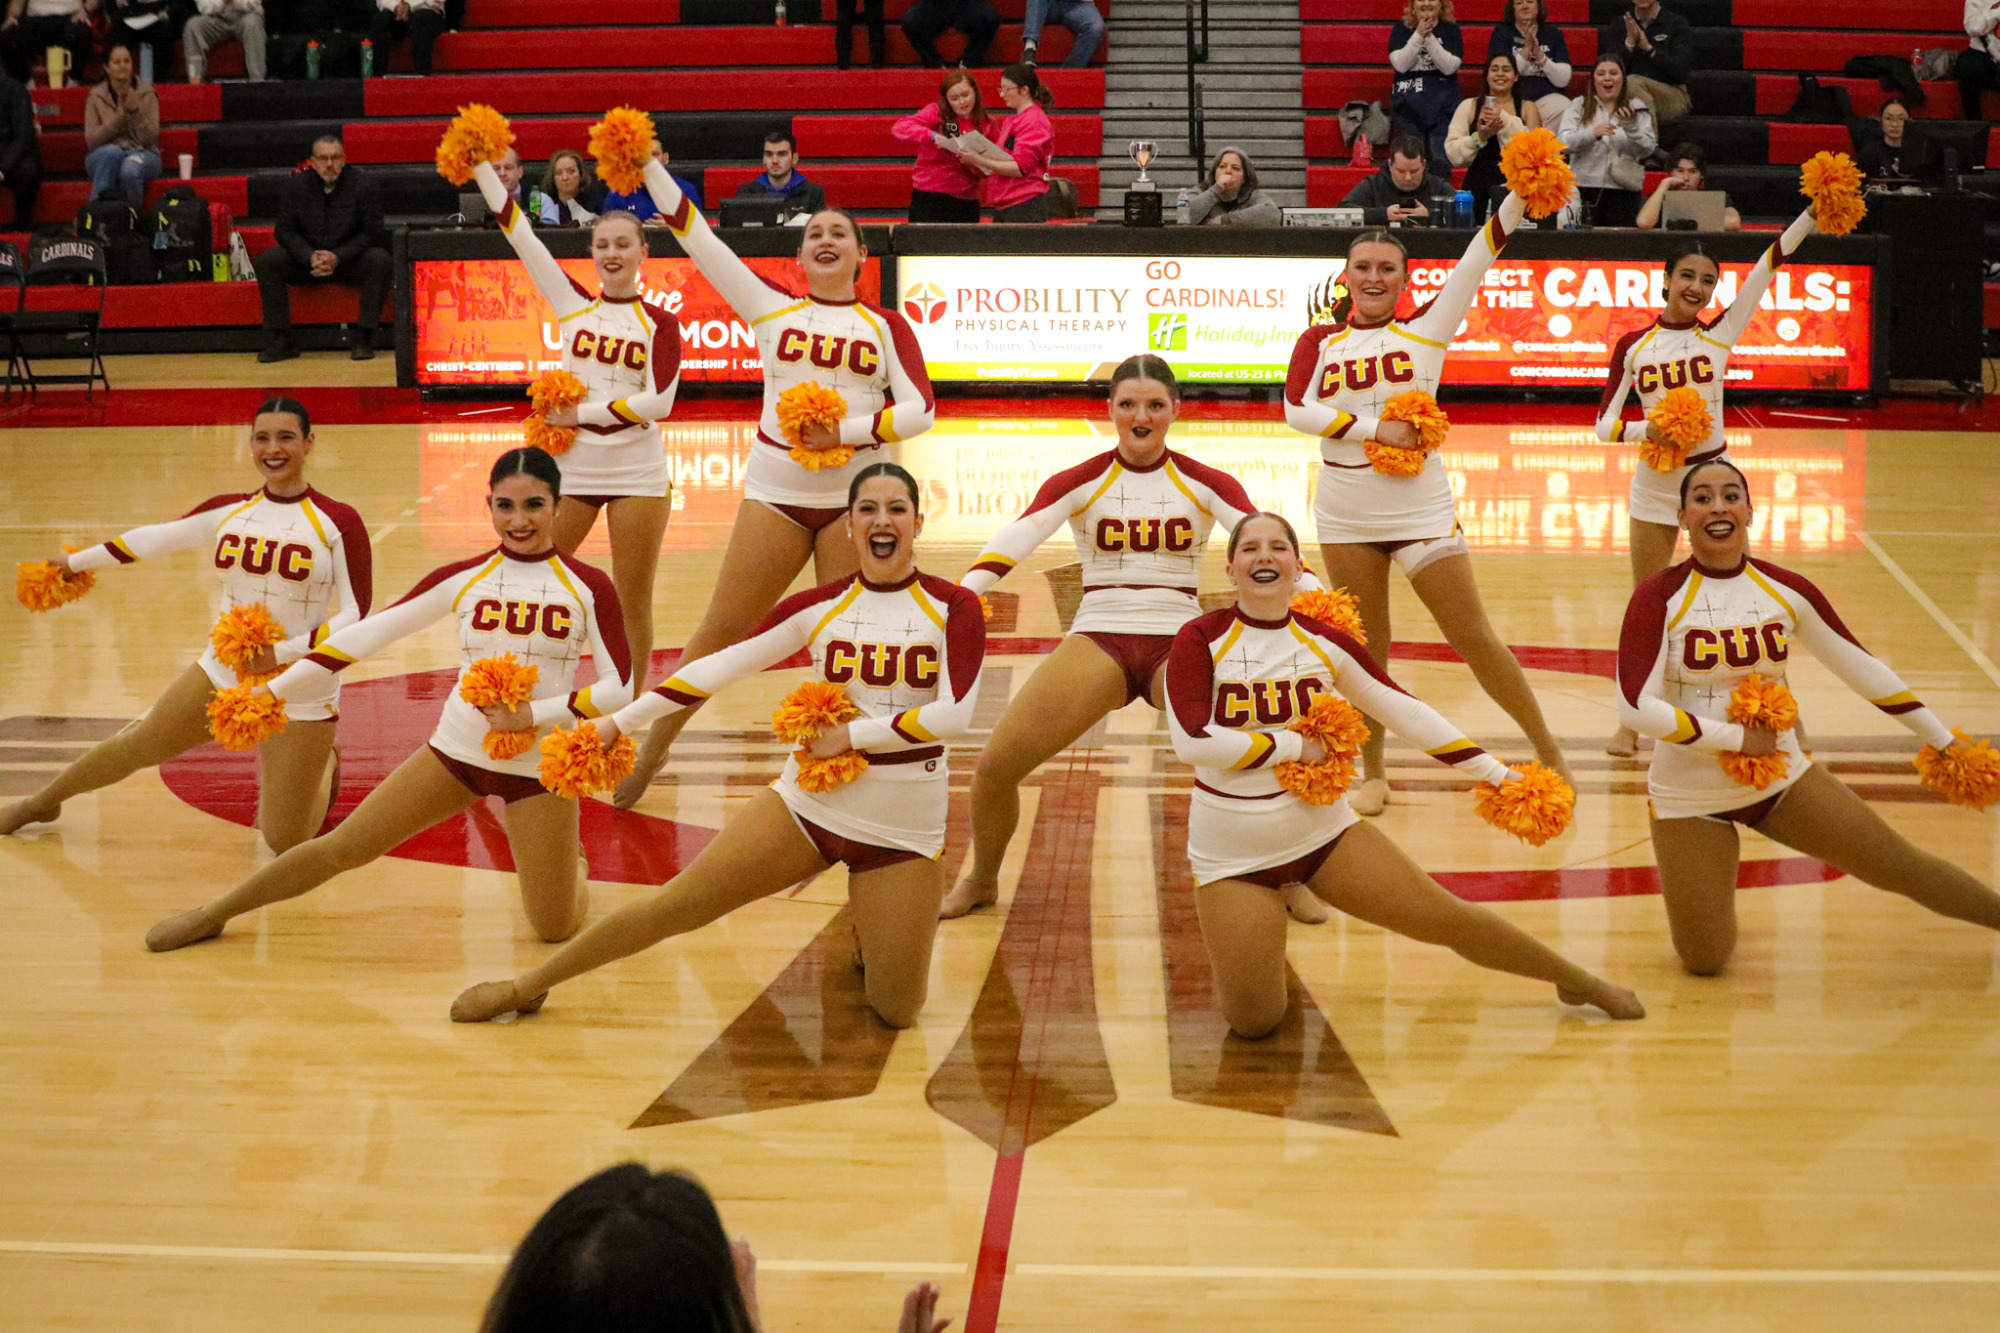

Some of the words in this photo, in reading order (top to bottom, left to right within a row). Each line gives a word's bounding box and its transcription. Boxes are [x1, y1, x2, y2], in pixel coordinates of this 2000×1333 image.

[41, 242, 95, 263] CARDINALS
[1145, 261, 1182, 280] GO
[1411, 267, 1534, 287] COECT
[956, 288, 1130, 313] PROBILITY
[1145, 288, 1284, 308] CARDINALS!
[1483, 290, 1534, 308] THE
[955, 319, 1040, 331] PHYSICAL
[1049, 319, 1128, 331] THERAPY
[1195, 325, 1268, 347] Holiday
[1270, 325, 1299, 342] Inn
[571, 328, 648, 371] CUC
[776, 327, 880, 379] CUC
[426, 361, 524, 372] CHRIST-CENTERED
[1188, 368, 1223, 379] located
[1224, 370, 1234, 379] at
[1235, 369, 1264, 379] US-23
[1265, 370, 1273, 379] &
[1273, 369, 1287, 381] Ply
[1317, 349, 1415, 401] CUC
[1638, 354, 1714, 394] CUC
[1094, 515, 1194, 553] CUC
[213, 531, 315, 583] CUC
[470, 597, 573, 642] CUC
[1681, 620, 1789, 672] CUC
[823, 637, 940, 691] CUC
[1214, 675, 1323, 729] CUC
